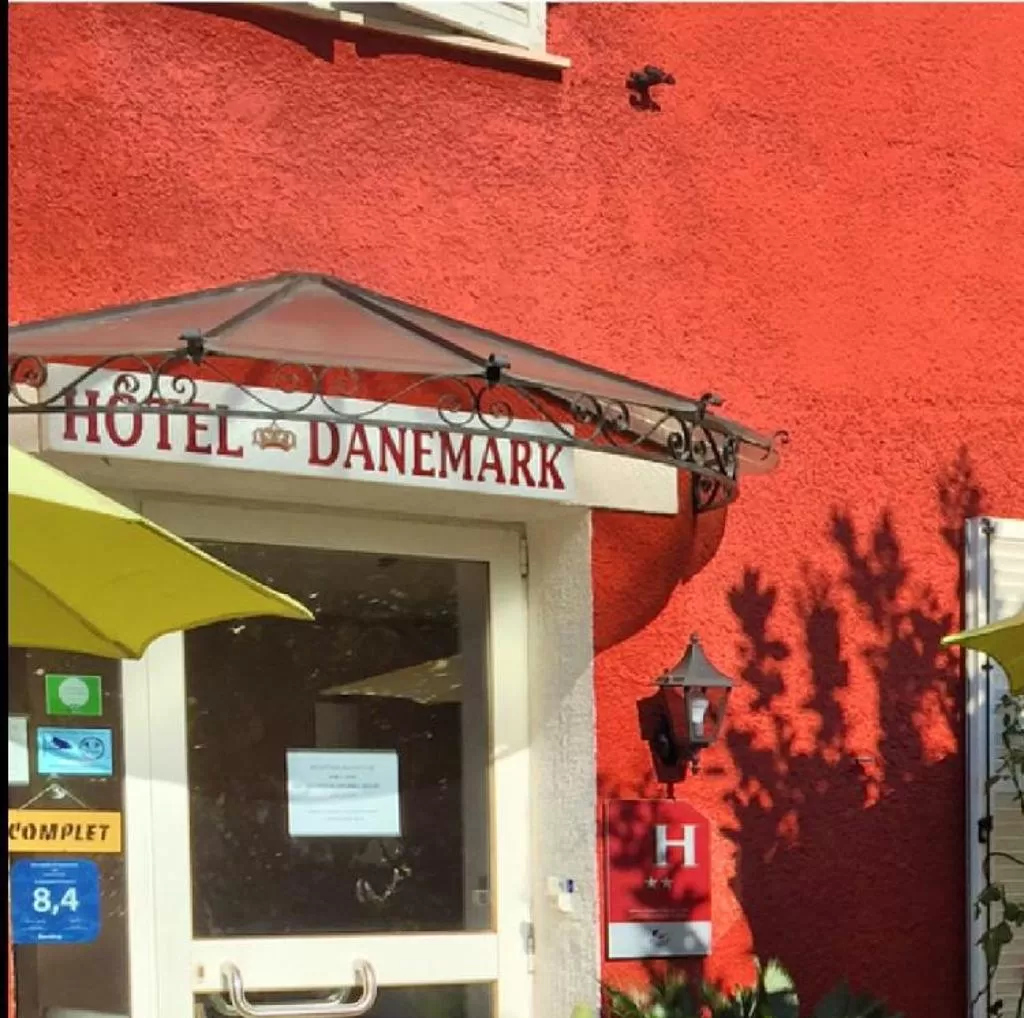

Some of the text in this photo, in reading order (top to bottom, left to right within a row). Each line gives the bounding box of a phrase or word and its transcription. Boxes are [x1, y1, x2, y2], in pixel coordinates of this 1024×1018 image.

[308, 419, 566, 490] DANEMARK
[9, 822, 110, 841] COMPLET
[655, 823, 699, 868] H
[33, 886, 80, 916] 8,4
